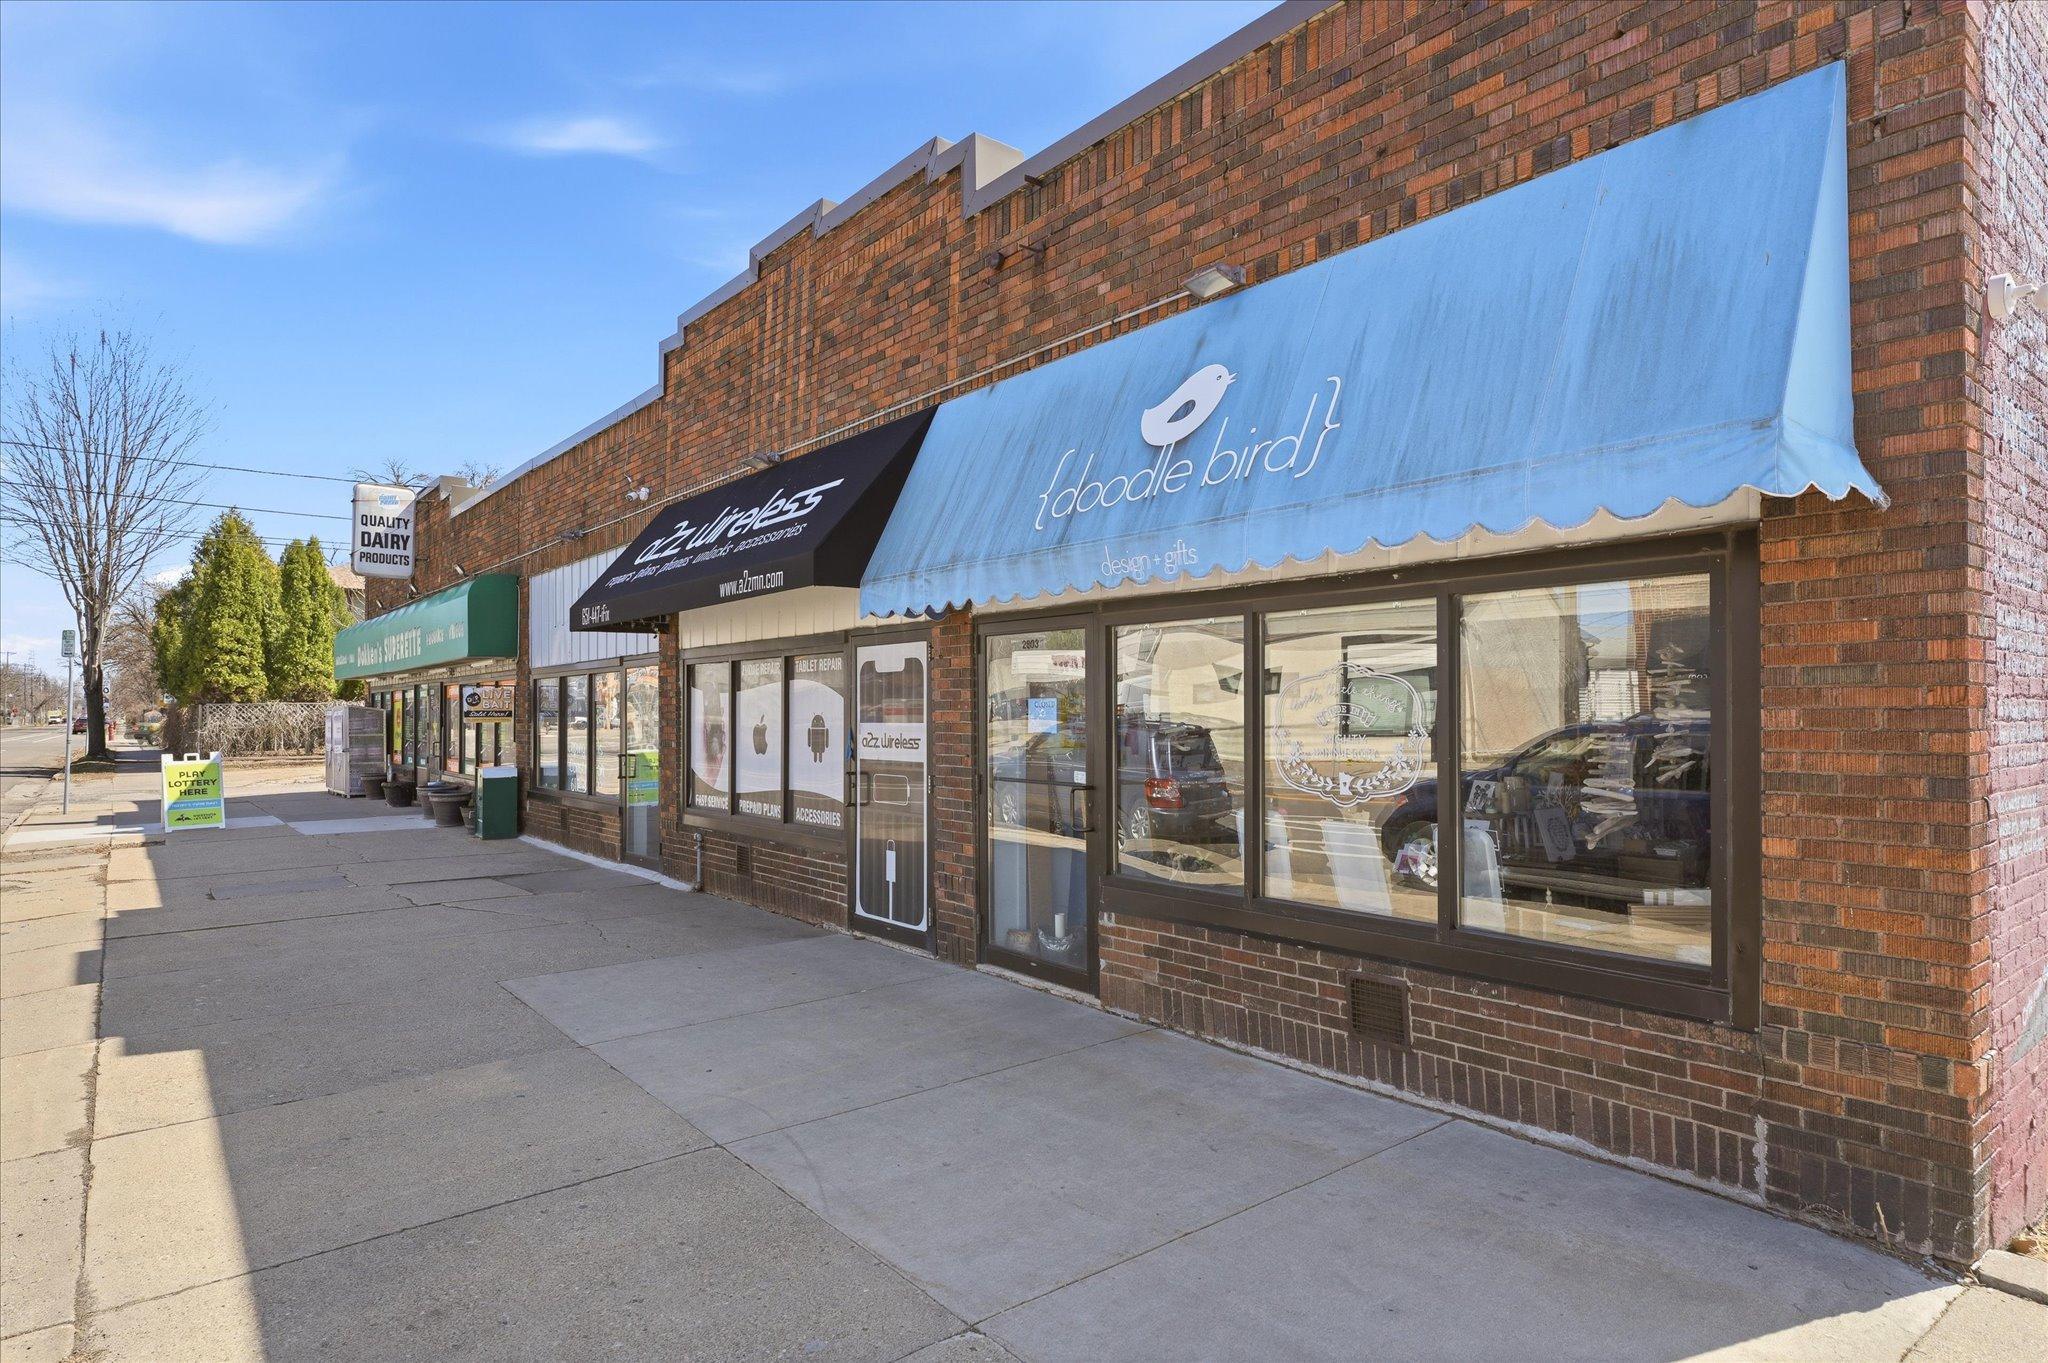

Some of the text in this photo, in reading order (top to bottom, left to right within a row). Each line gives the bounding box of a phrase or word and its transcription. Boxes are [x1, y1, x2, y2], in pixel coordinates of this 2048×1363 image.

[360, 514, 410, 530] QUALITY
[634, 477, 845, 565] a2z wireless
[360, 531, 411, 551] DAIRY
[732, 523, 808, 553] accessories
[360, 551, 410, 566] PRODUCTS
[1101, 543, 1152, 580] design
[1164, 539, 1198, 575] gifts
[719, 569, 784, 599] www.a2zmn.com
[384, 627, 421, 663] SUPERETTE
[1021, 639, 1040, 650] 2803
[795, 656, 842, 673] TABLET REPAIR
[482, 689, 512, 700] LIVE
[482, 700, 511, 710] BAIT
[861, 731, 922, 750] a2z wireless
[178, 770, 206, 778] PLAY
[168, 778, 218, 788] LOTTERY
[179, 788, 208, 796] HERE
[695, 794, 729, 810] FAST SERVICE
[739, 799, 781, 818] PREPAID PLANS
[795, 807, 841, 827] ACCESSORIES
